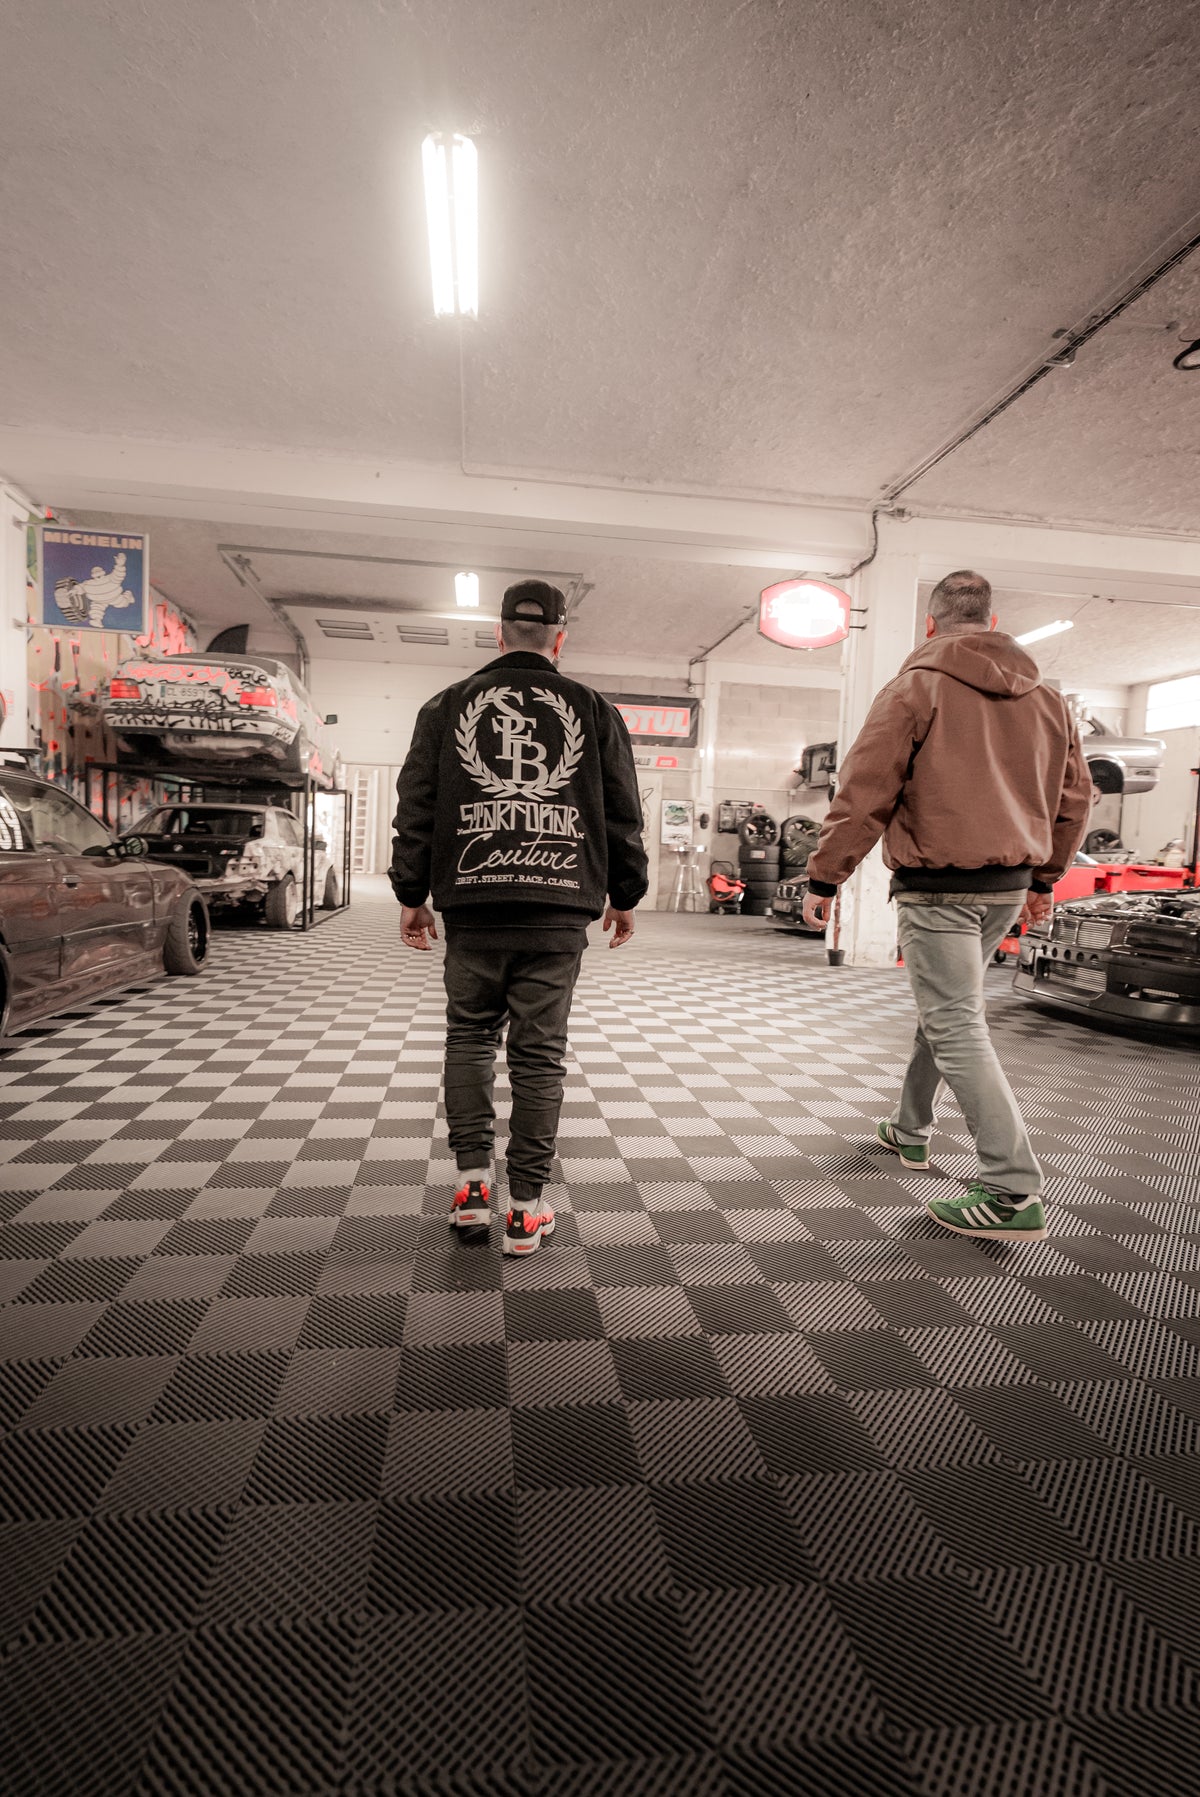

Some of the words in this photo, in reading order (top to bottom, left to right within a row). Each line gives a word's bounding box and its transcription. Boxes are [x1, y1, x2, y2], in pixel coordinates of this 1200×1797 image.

[44, 531, 142, 550] MICHELIN
[620, 708, 688, 733] OTUL
[457, 832, 578, 873] Couture
